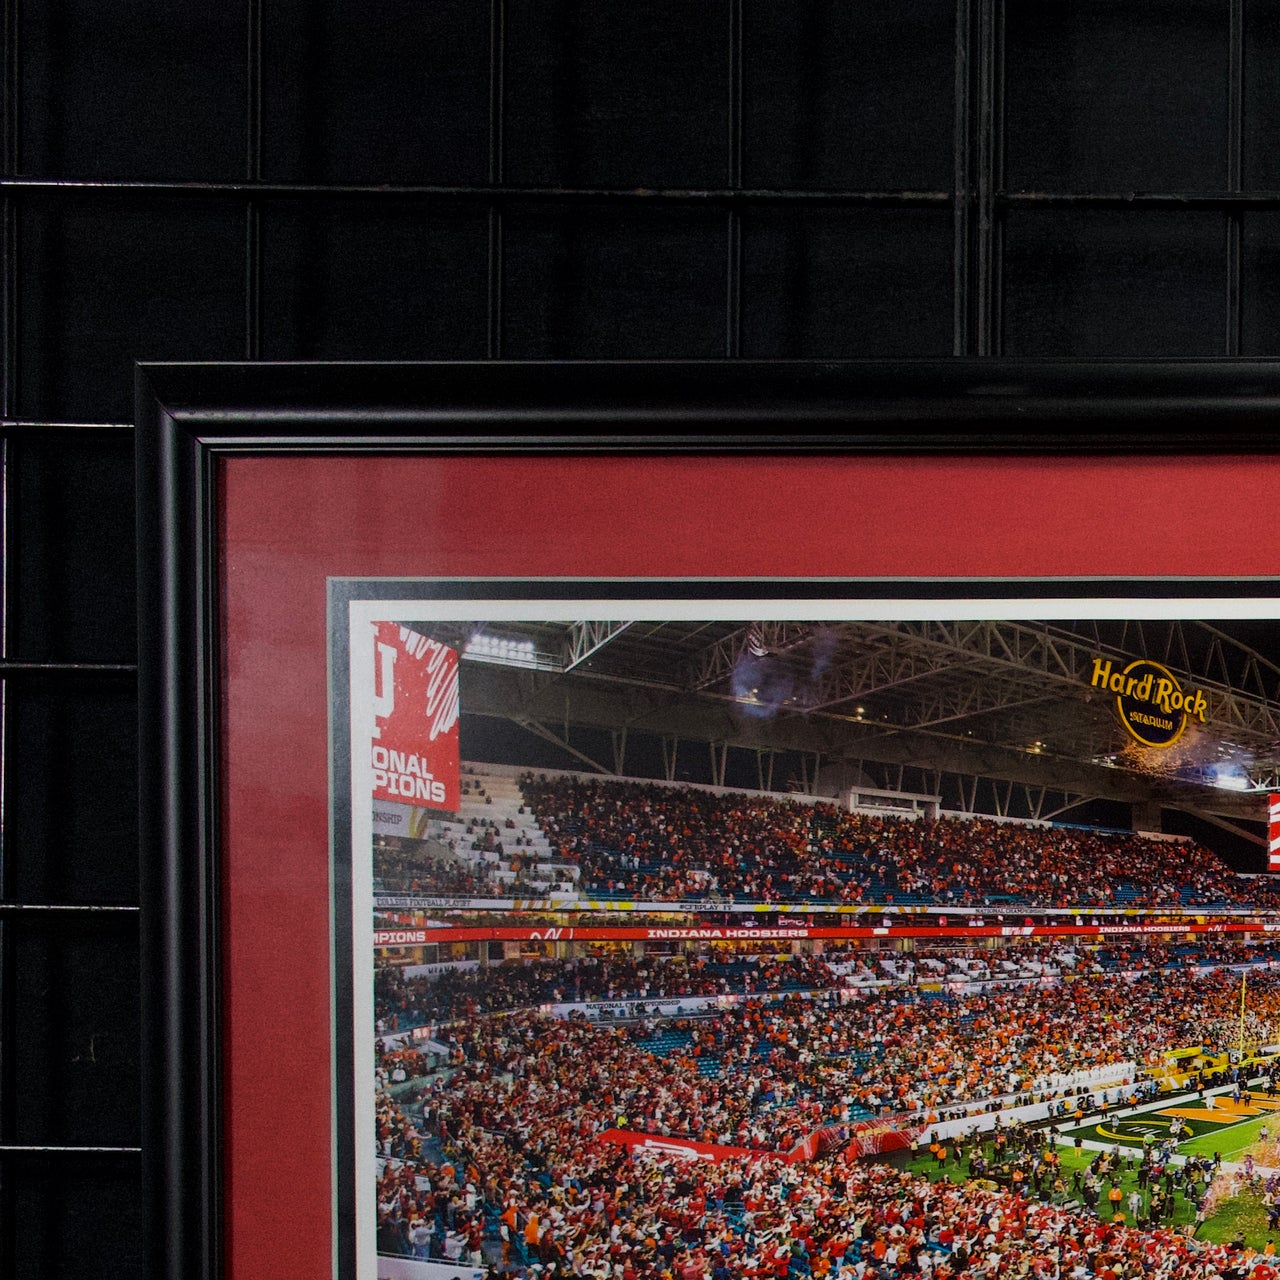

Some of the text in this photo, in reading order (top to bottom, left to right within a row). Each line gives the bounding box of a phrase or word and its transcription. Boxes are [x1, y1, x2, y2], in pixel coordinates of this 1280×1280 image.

[1091, 658, 1208, 723] Hard Rock
[1129, 711, 1173, 731] STADIUM
[647, 928, 809, 938] INDIANA HOOSIERS
[1098, 925, 1142, 933] INDIANA
[586, 1002, 625, 1010] NATIONAL
